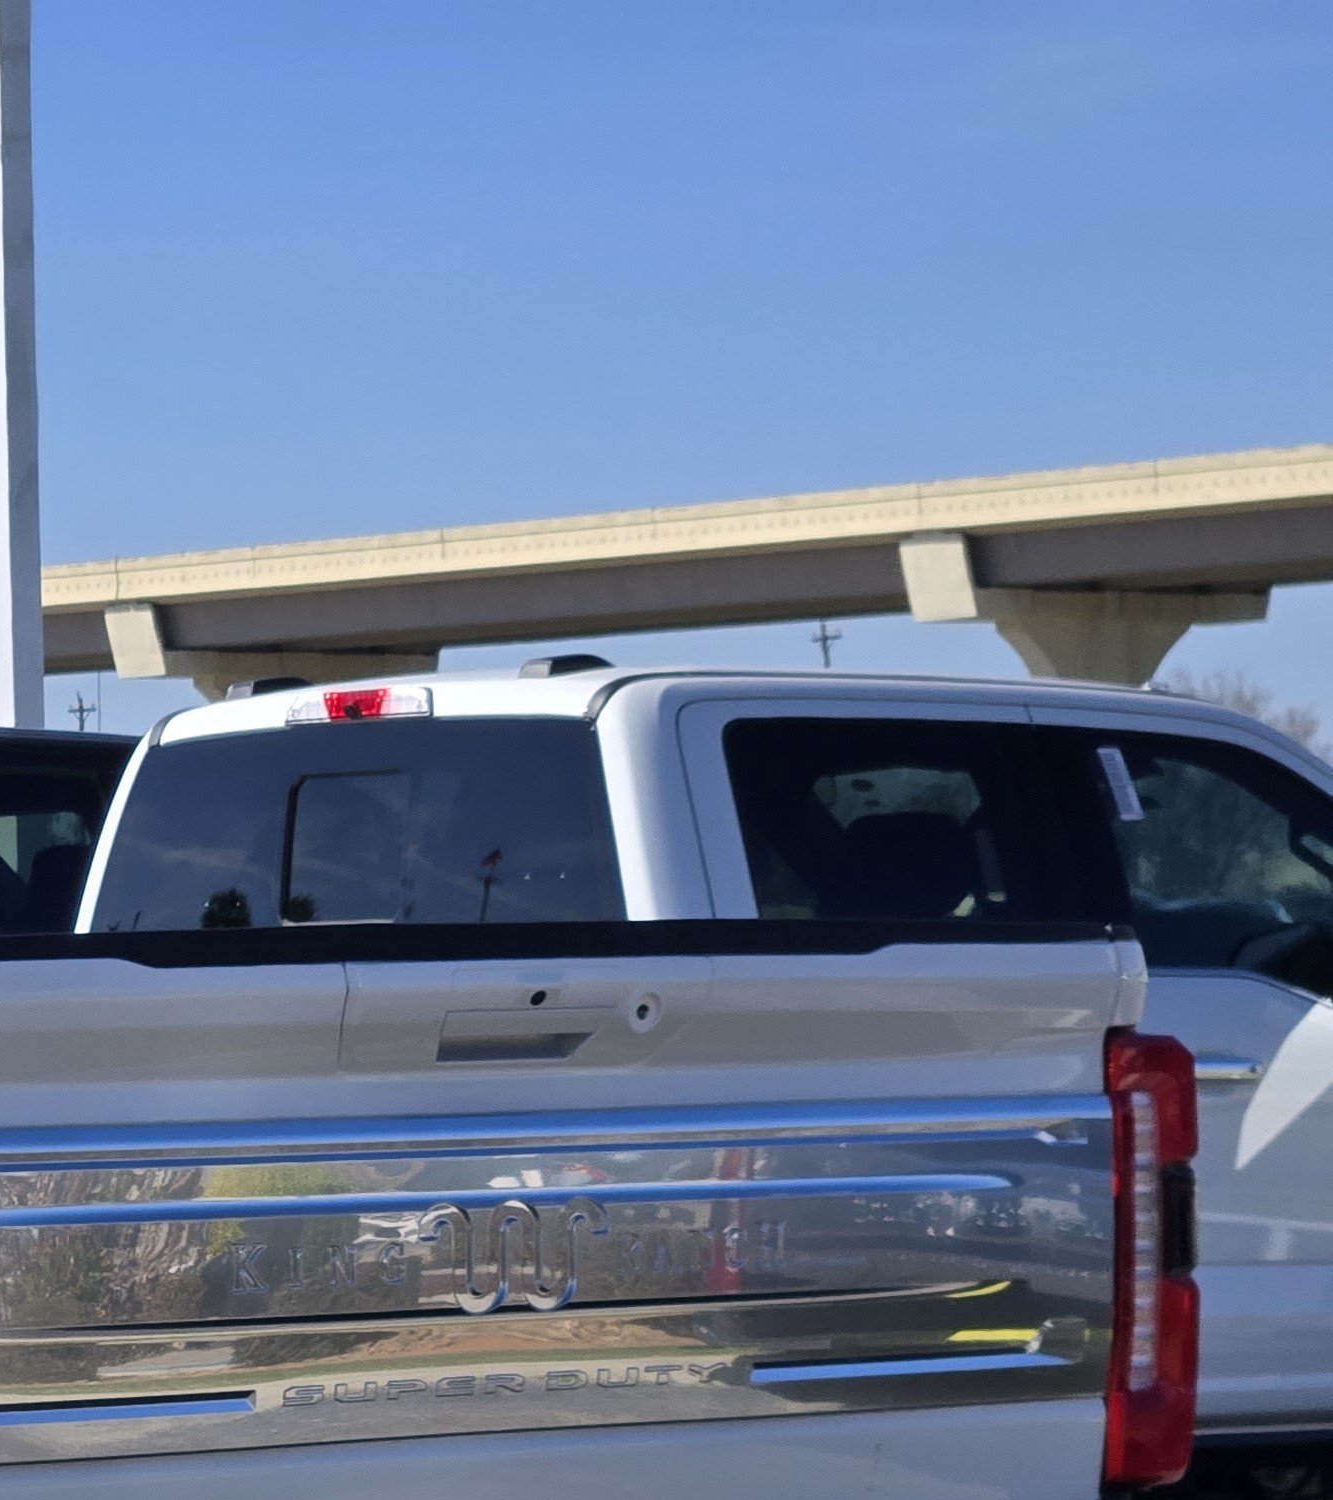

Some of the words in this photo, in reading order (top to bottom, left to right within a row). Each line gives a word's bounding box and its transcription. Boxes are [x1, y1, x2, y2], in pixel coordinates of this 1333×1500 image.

[229, 1241, 410, 1293] KING
[282, 1372, 527, 1408] SUPER
[545, 1362, 728, 1392] DUTY
